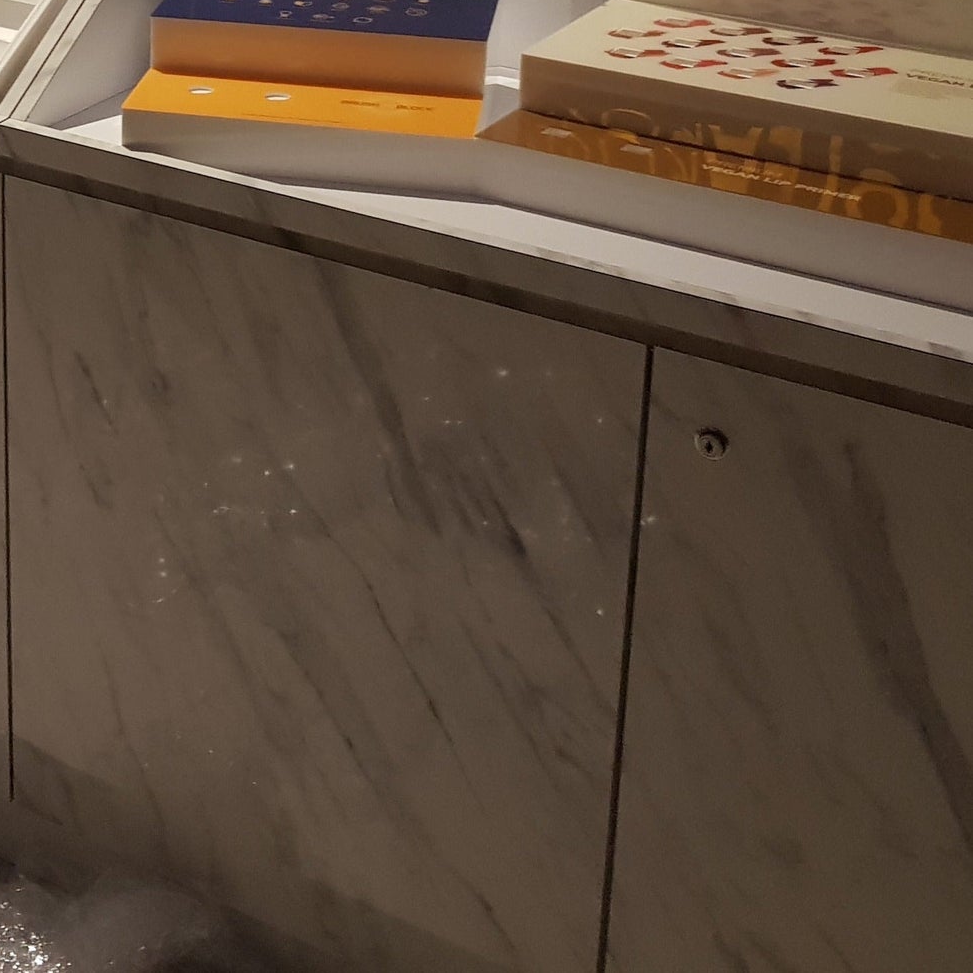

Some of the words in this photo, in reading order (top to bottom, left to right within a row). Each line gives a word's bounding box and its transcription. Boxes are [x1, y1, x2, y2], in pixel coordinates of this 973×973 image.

[702, 163, 762, 181] VEGAN
[762, 176, 793, 187] LIP
[794, 183, 863, 202] PRIMER
